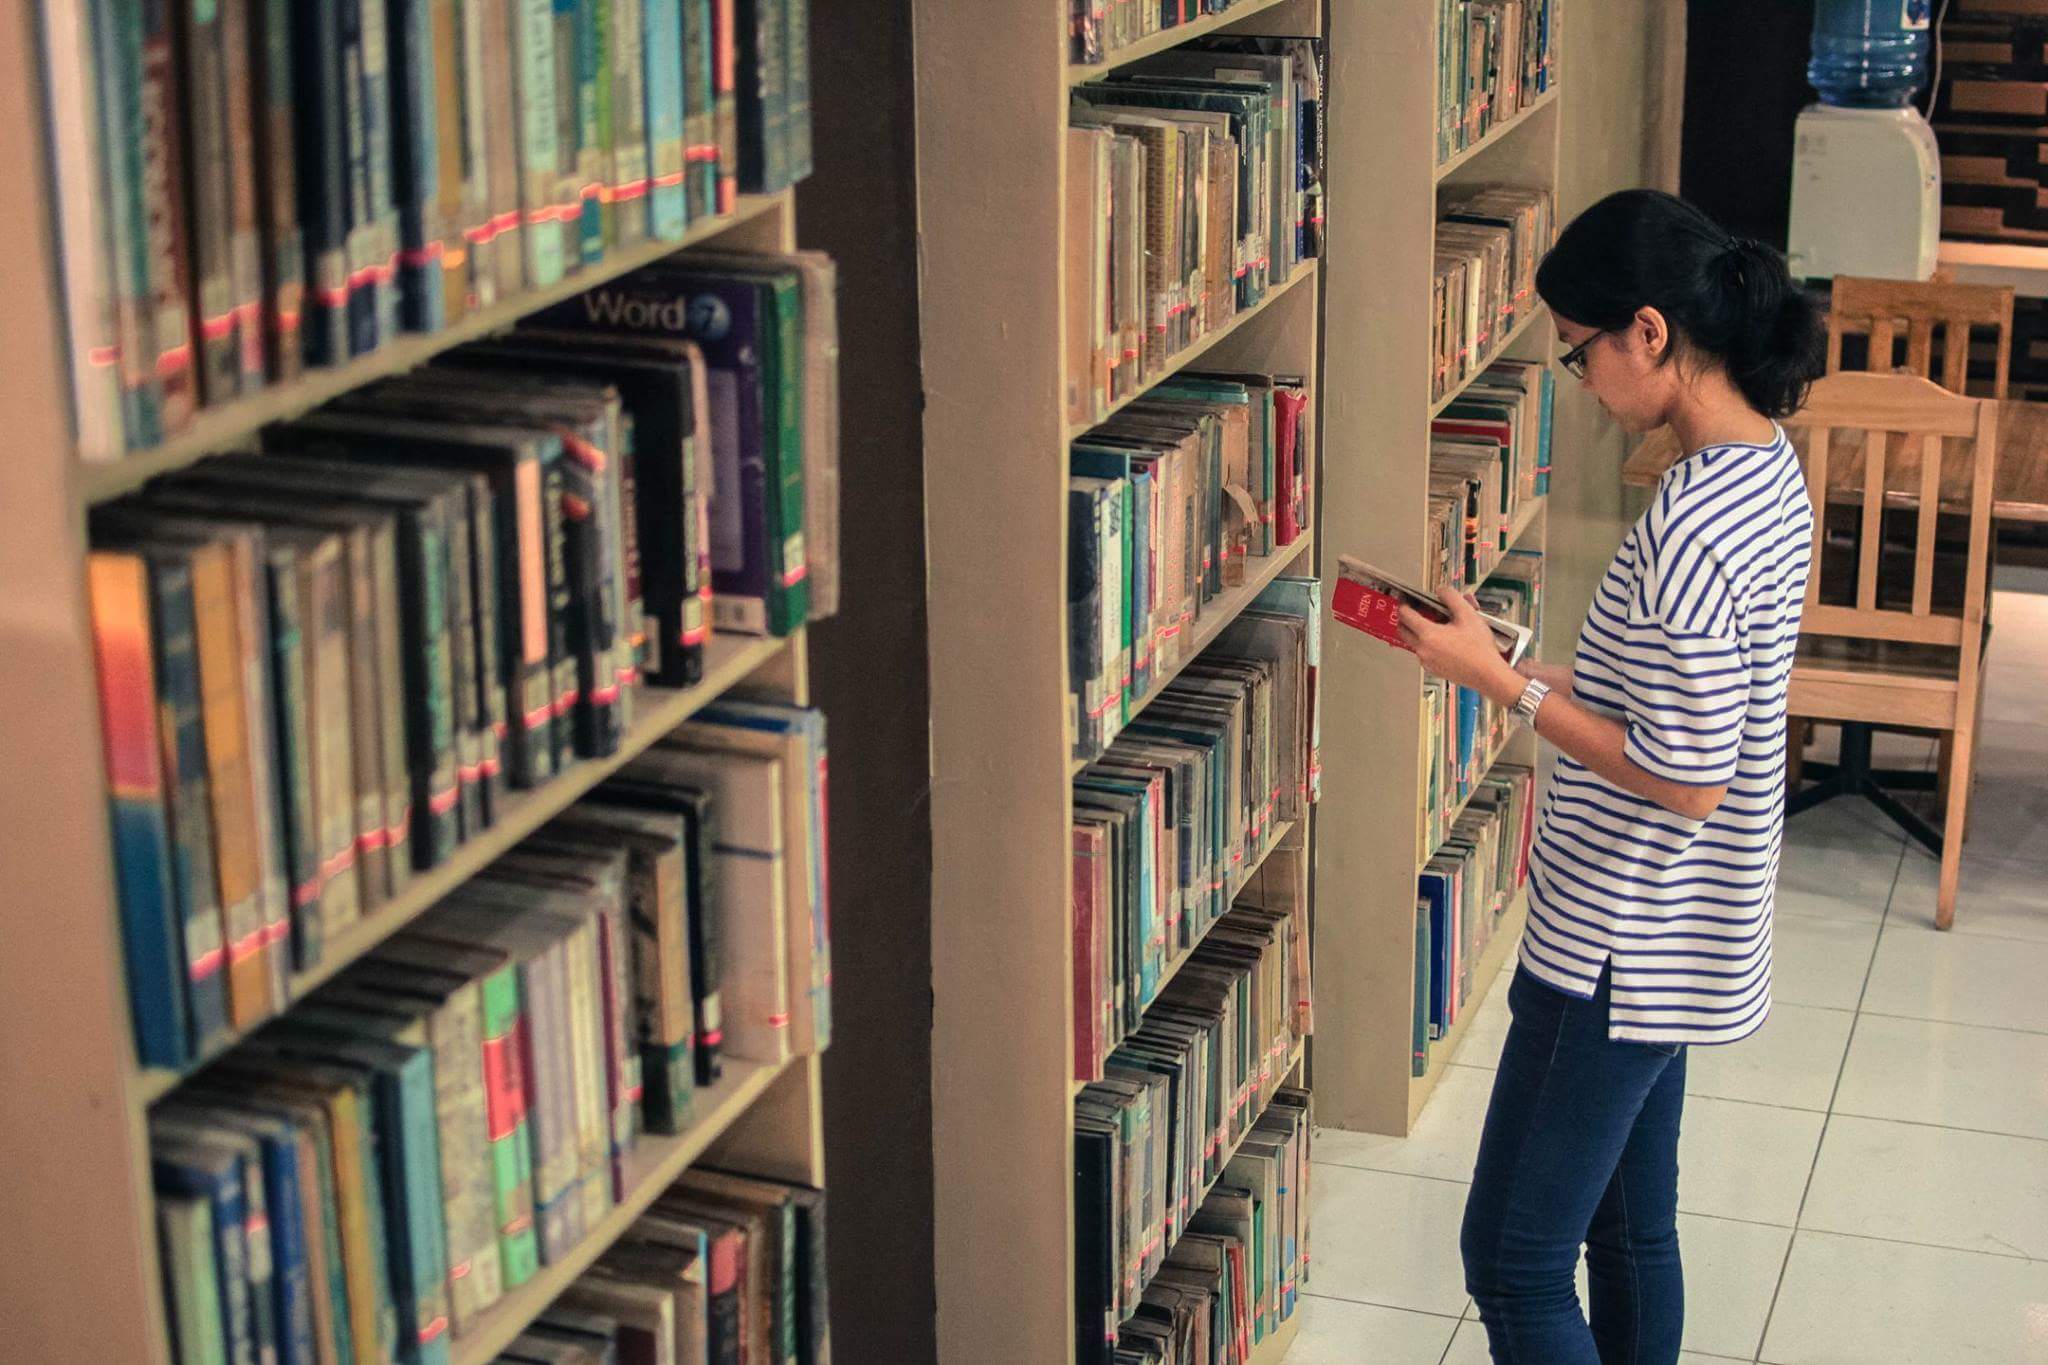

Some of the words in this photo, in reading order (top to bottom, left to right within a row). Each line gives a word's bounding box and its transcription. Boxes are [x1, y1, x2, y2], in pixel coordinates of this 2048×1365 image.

[584, 290, 685, 329] Word
[1358, 593, 1372, 617] LISTEN
[1376, 599, 1387, 611] TO
